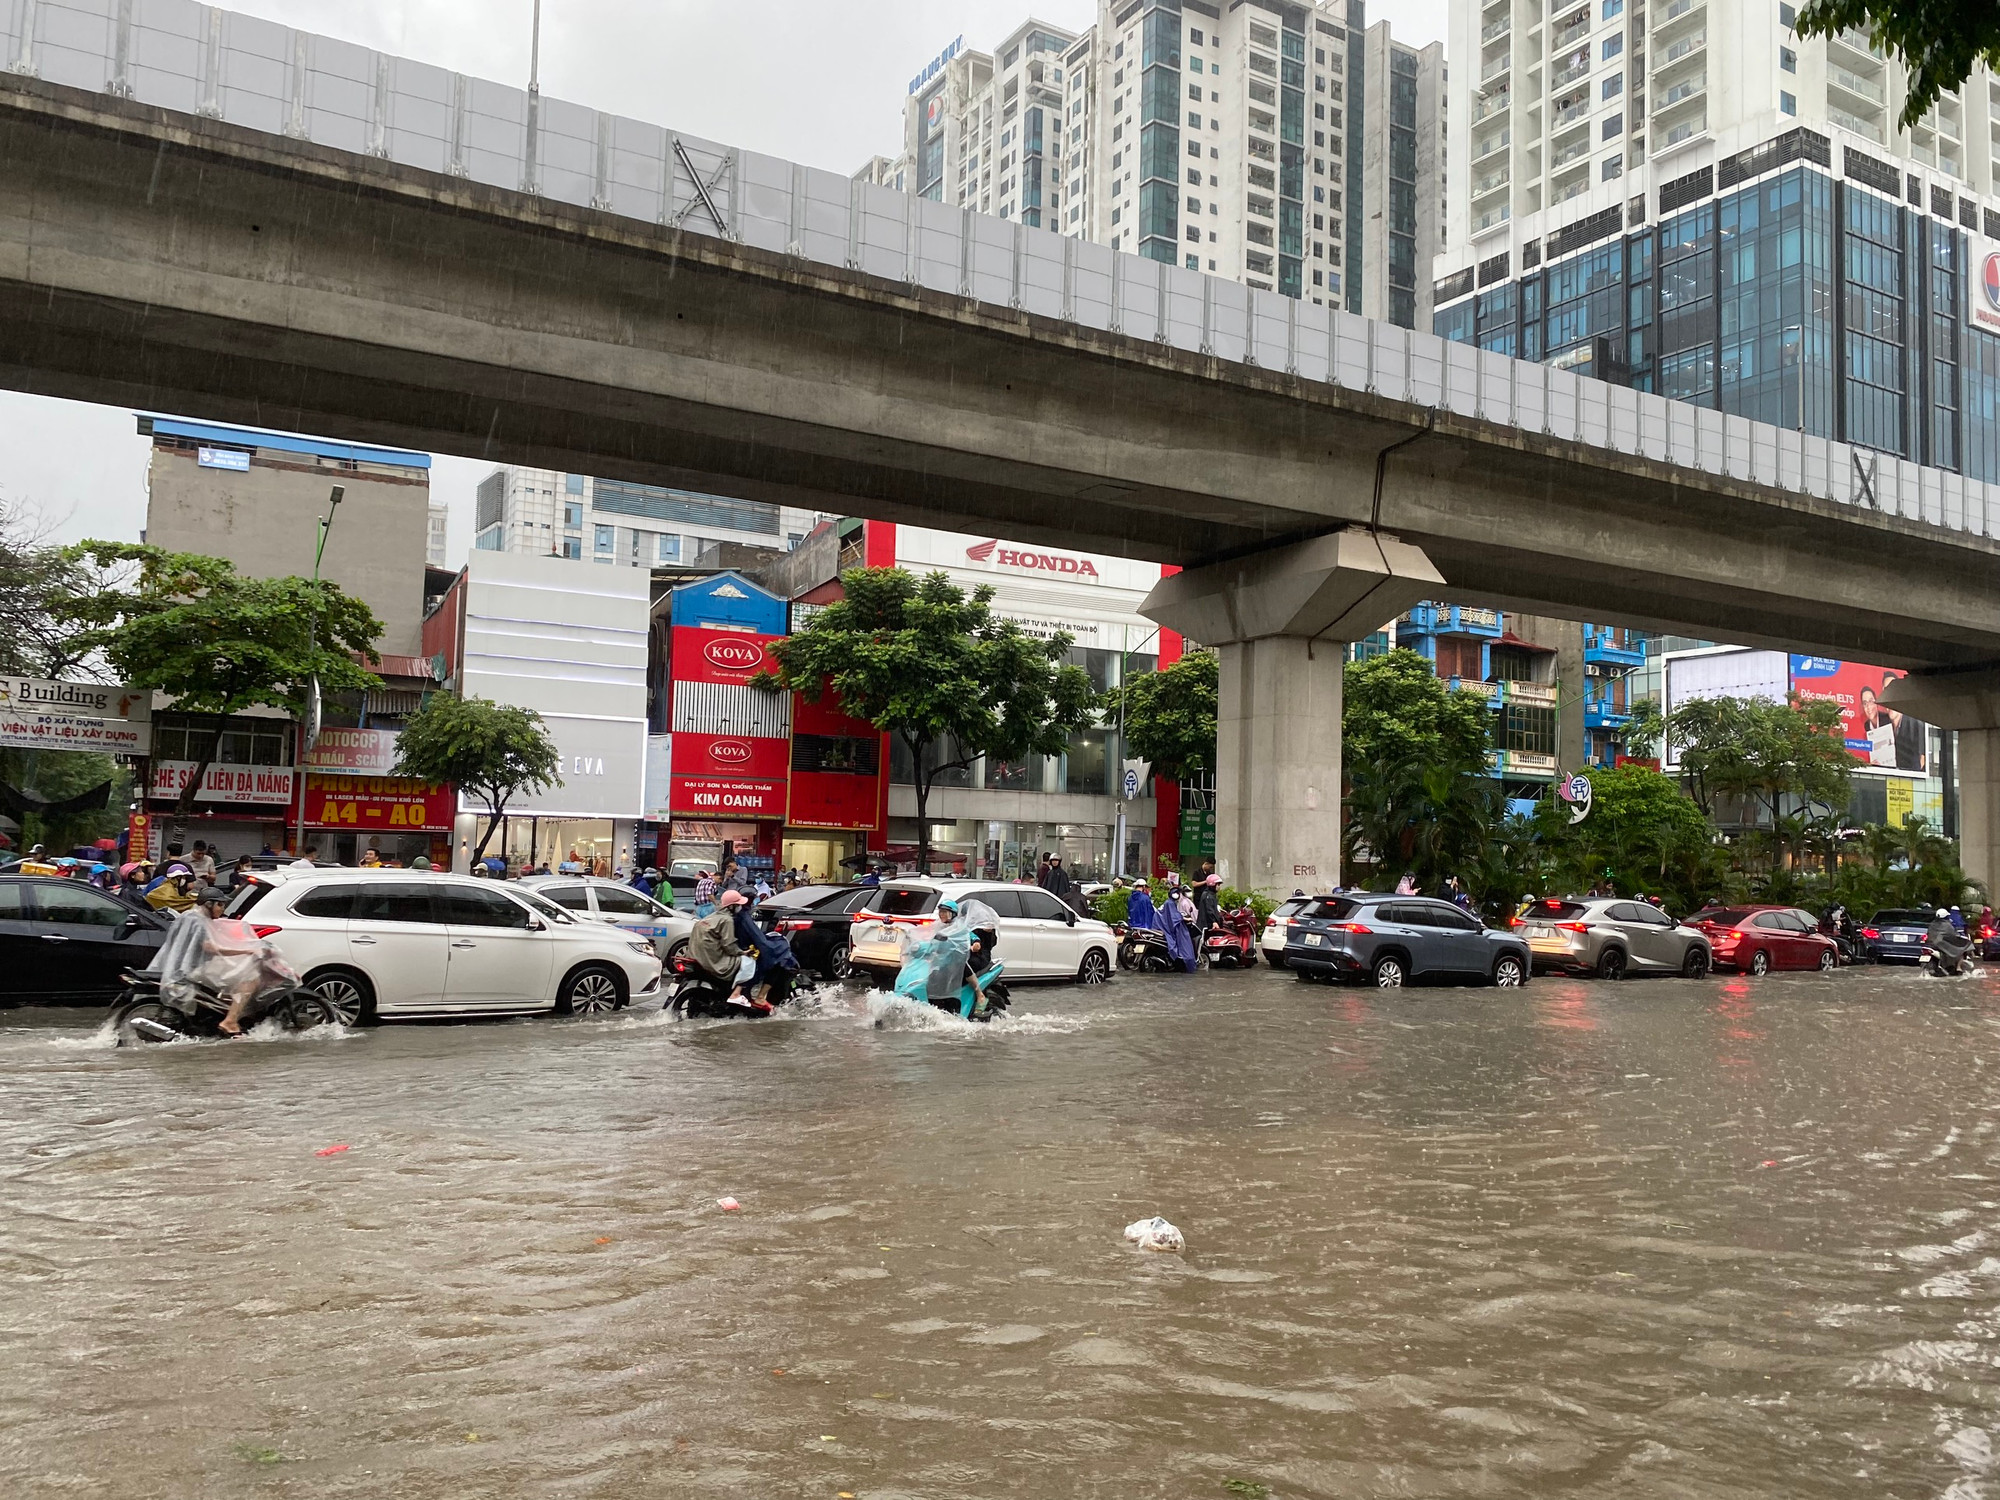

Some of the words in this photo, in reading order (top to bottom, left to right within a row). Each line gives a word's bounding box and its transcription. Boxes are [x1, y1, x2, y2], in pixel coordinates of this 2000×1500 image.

[998, 549, 1098, 576] HONDA
[1090, 625, 1098, 634] BỘ
[712, 647, 754, 660] KOVA
[20, 682, 108, 709] Building
[1836, 693, 1854, 704] IELTS
[38, 716, 52, 724] BỘ
[54, 716, 74, 724] XÂY
[76, 719, 104, 727] DỰNG
[2, 723, 27, 734] VIỆN
[31, 724, 52, 737] VẬT
[54, 726, 79, 738] LIỆU
[81, 727, 103, 739] XÂY
[105, 731, 138, 742] DỰNG
[317, 731, 385, 749] HOTOCOPY
[714, 746, 746, 757] KOVA
[356, 754, 385, 767] SCAN
[574, 756, 604, 775] EVA
[152, 765, 175, 788] CHÈ
[178, 763, 202, 789] SẦ
[207, 768, 234, 791] LIÊN
[237, 769, 253, 792] ĐÀ
[257, 767, 290, 793] NẴNG
[308, 774, 440, 795] PHOTOCOPY
[234, 793, 251, 801] 237
[694, 793, 720, 806] KIM
[723, 794, 762, 807] OANH
[321, 801, 358, 823] A4
[1293, 865, 1316, 876] ER18
